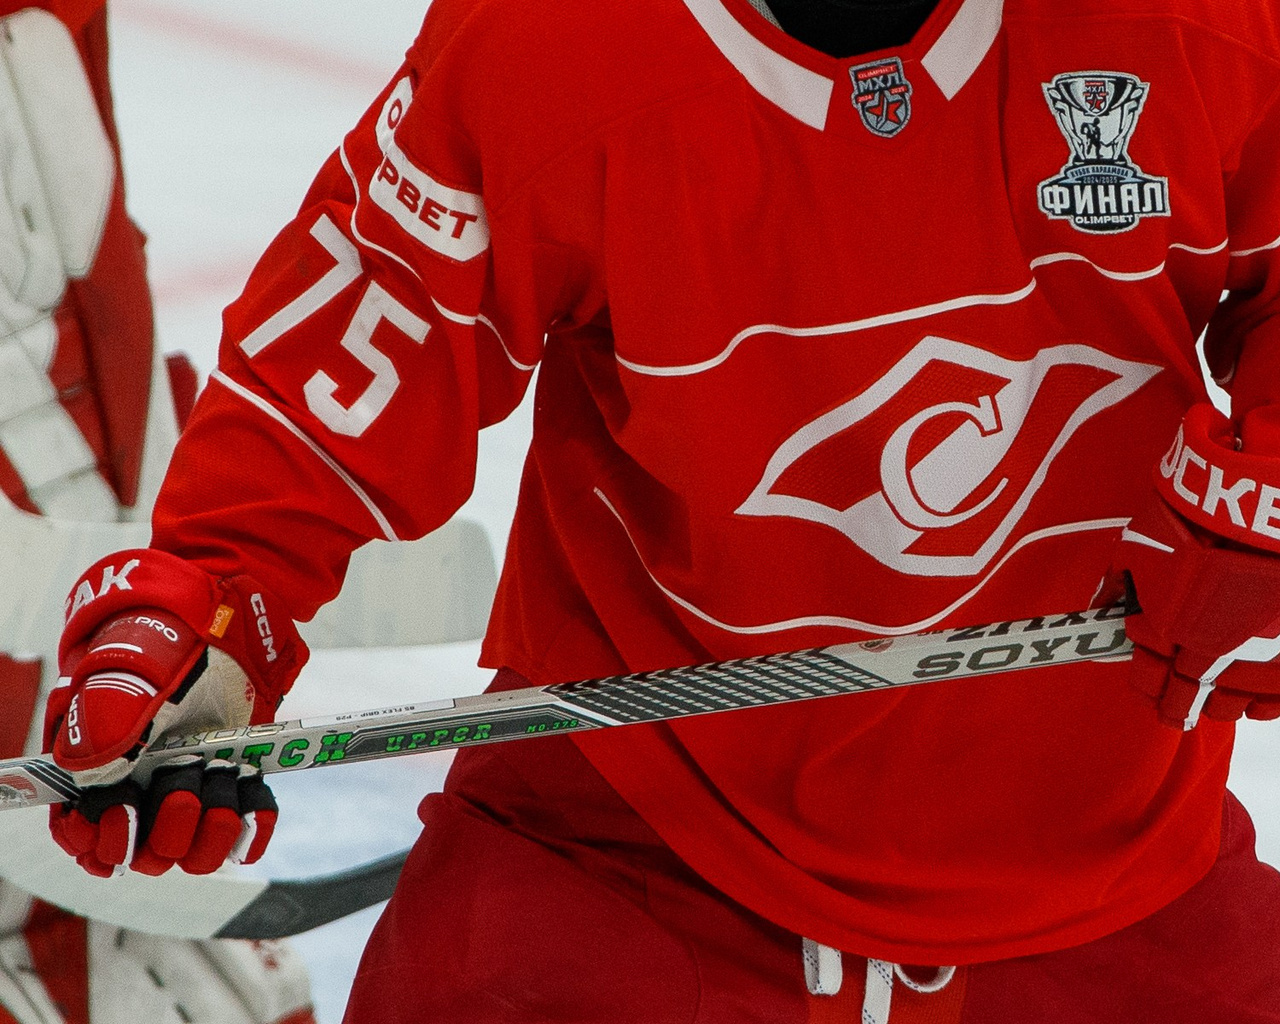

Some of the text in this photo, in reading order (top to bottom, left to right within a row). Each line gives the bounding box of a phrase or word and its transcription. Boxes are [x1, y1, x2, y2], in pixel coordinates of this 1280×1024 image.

[858, 71, 901, 93] МХЛ
[1085, 85, 1105, 93] МХЛ
[1042, 183, 1164, 215] ФИНАЛ
[1075, 214, 1134, 224] OLIMPBET
[239, 213, 432, 438] 75
[134, 616, 179, 642] PRO
[250, 593, 278, 663] CCM
[912, 630, 1136, 678] SOYU
[385, 724, 491, 752] UPPER
